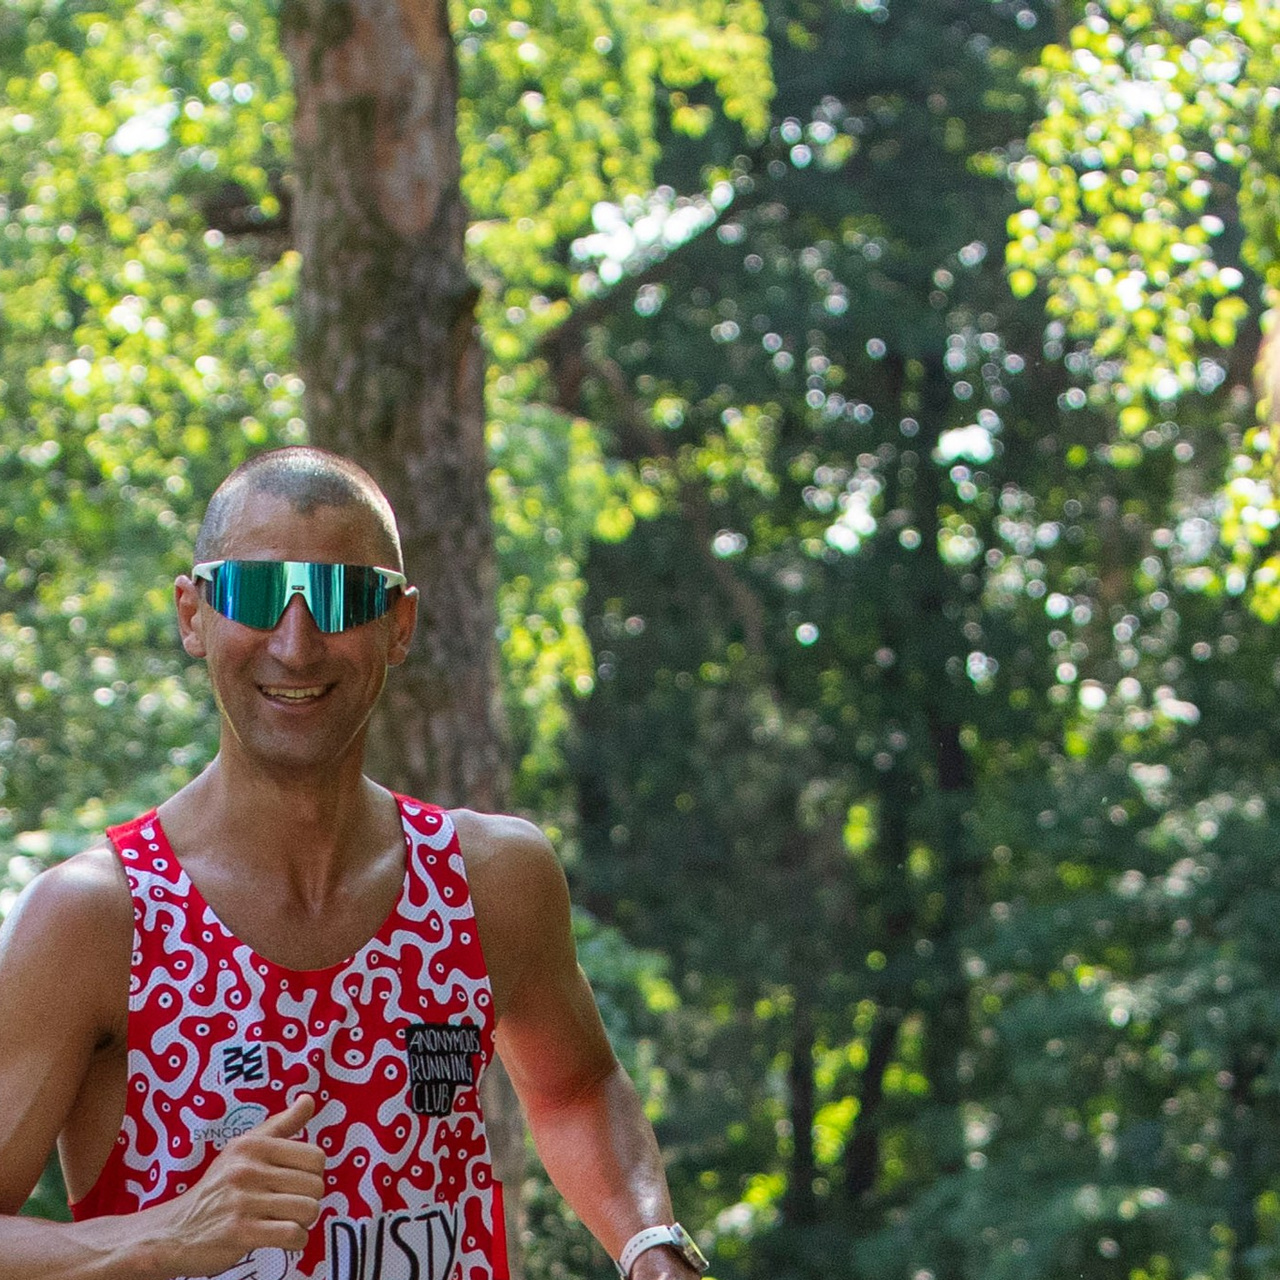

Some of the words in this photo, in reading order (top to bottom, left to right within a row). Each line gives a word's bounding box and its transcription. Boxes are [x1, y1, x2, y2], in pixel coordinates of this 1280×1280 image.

[409, 1029, 479, 1052] ANONYMOUS
[410, 1054, 472, 1083] RUNNING
[412, 1083, 450, 1112] CLUB
